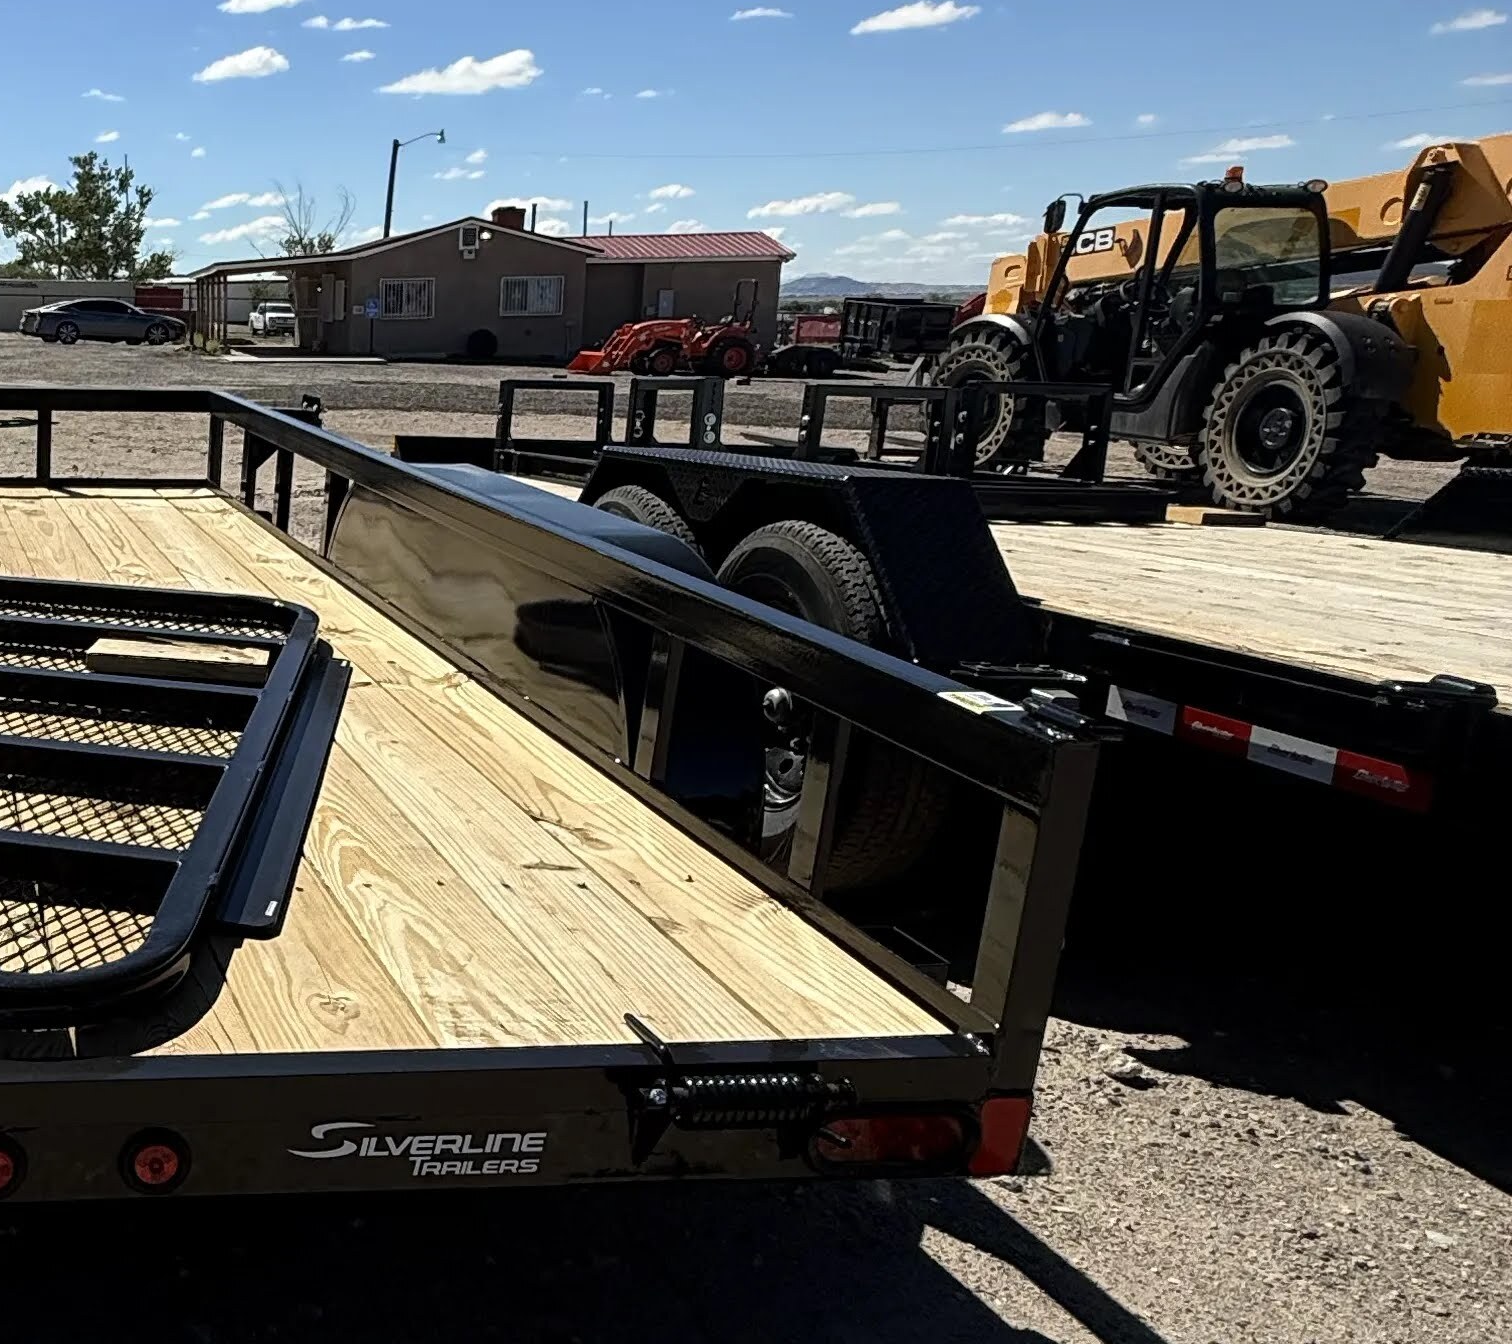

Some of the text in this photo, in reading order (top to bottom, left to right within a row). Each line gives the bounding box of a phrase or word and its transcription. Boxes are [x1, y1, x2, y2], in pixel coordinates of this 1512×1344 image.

[1067, 229, 1114, 255] CB
[288, 1121, 548, 1158] SILVERLINE
[409, 1156, 540, 1176] TRAILERS
